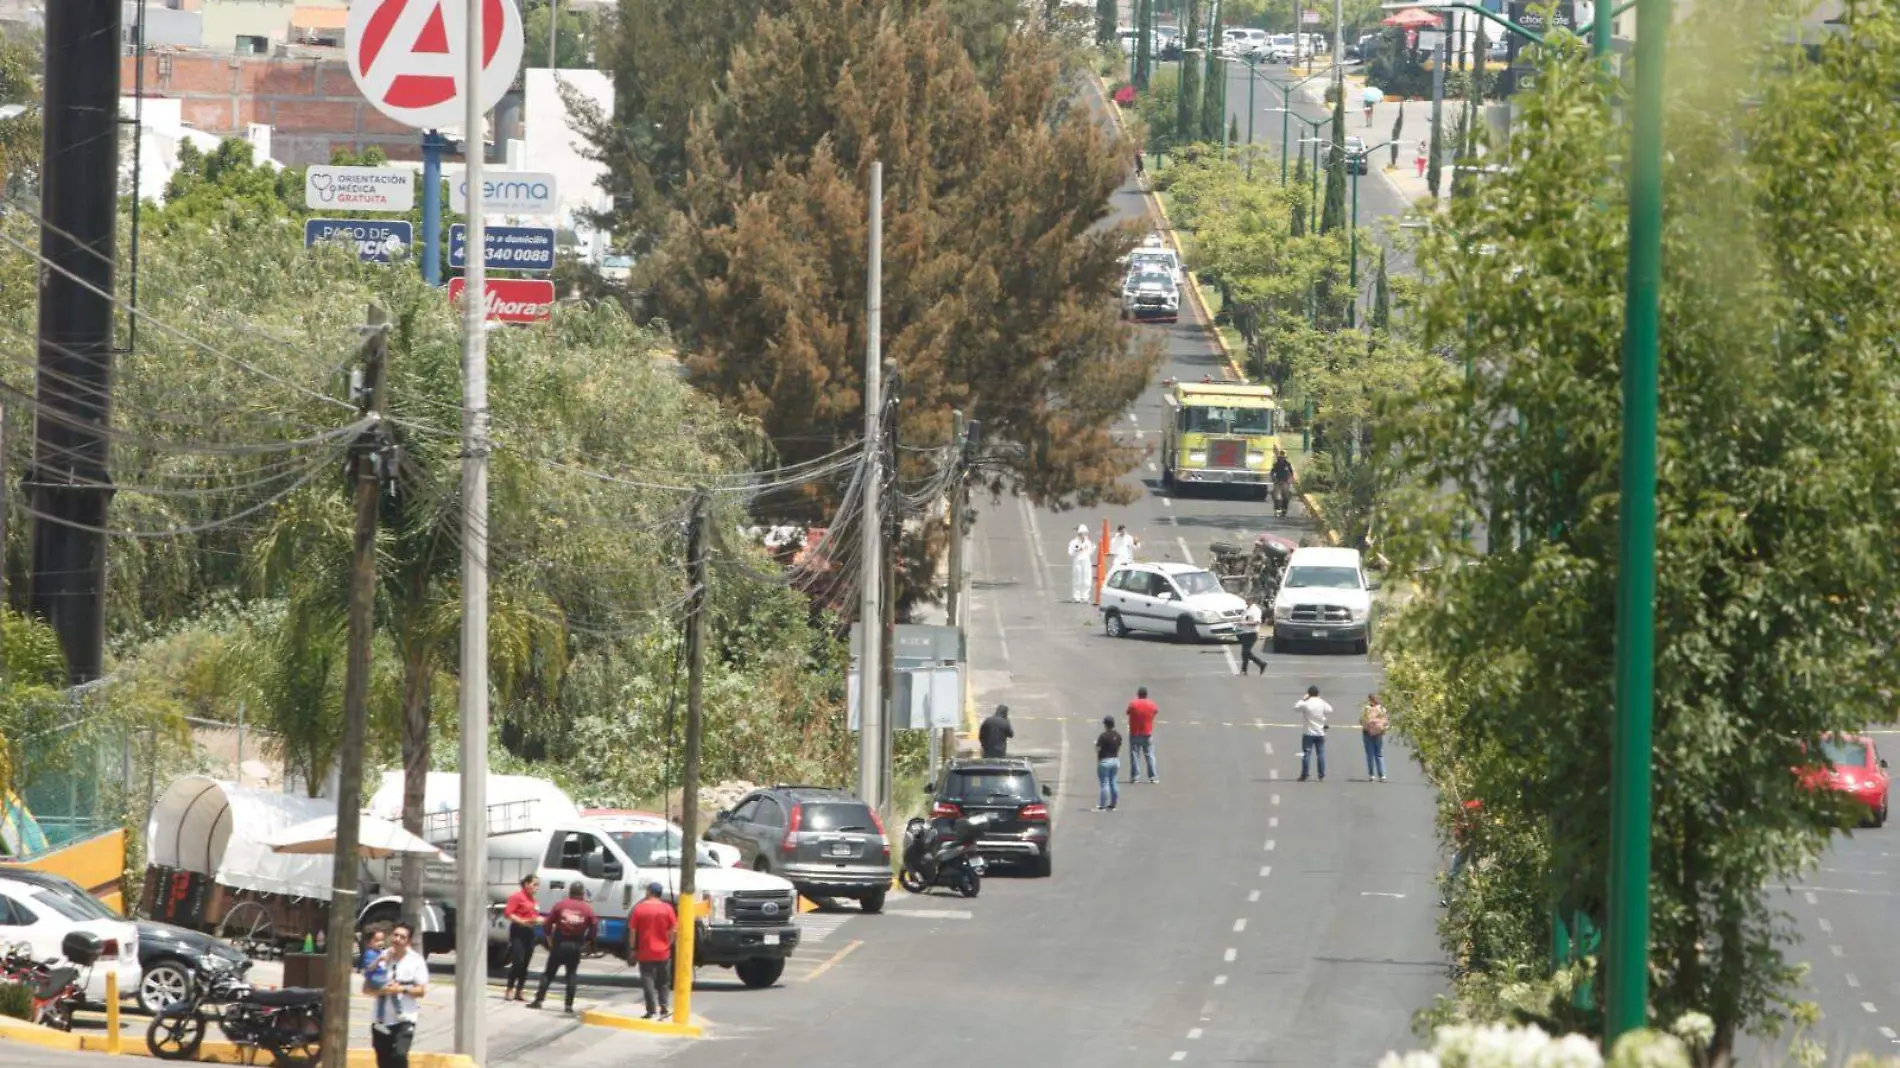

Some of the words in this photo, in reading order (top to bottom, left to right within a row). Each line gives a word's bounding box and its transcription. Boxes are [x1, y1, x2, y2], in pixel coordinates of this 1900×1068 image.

[337, 193, 387, 204] GRATUITA
[369, 228, 391, 240] DE
[505, 234, 549, 246] domicilio
[513, 249, 550, 262] 0088
